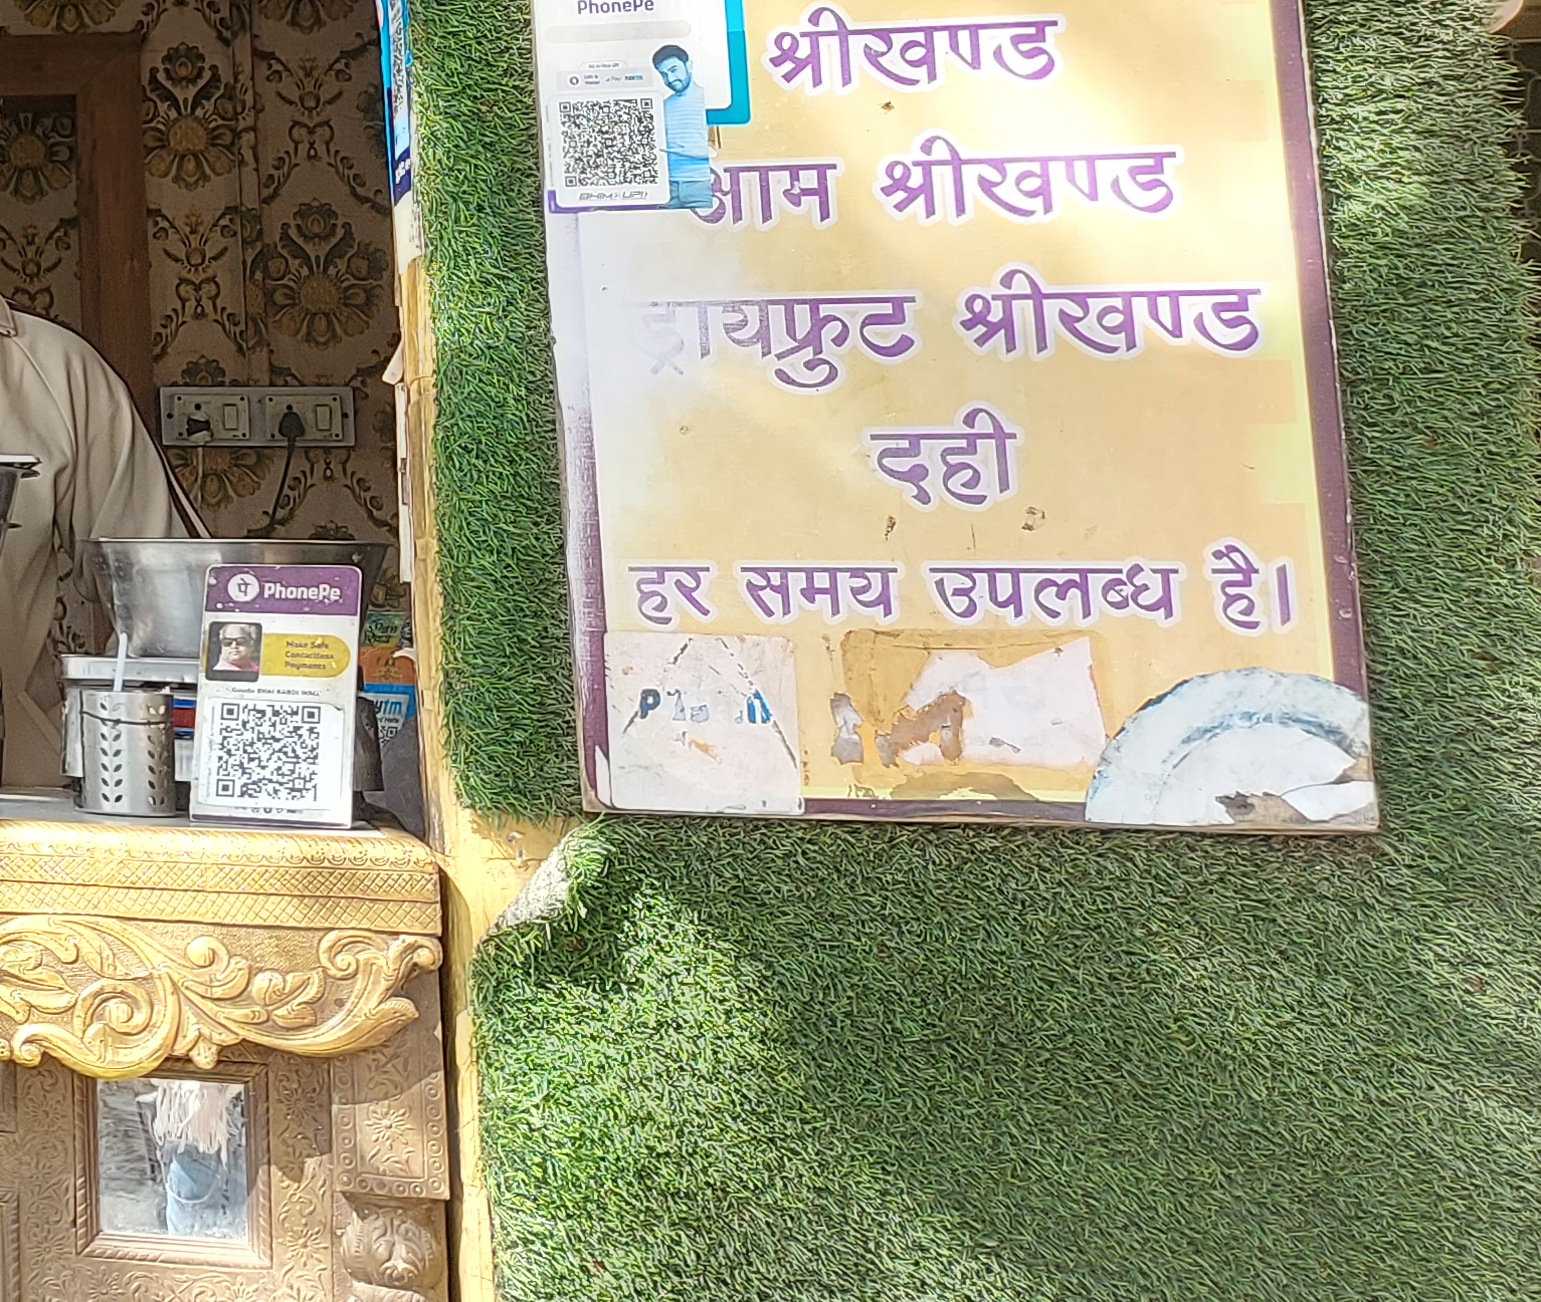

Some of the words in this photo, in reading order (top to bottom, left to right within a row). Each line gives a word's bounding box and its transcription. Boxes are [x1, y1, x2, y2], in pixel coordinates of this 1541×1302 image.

[769, 9, 1060, 88] श्रीखण्ड
[883, 135, 1176, 219] श्रीखण्ड
[959, 268, 1262, 354] श्रीखण्ड
[869, 408, 1018, 504] दही
[264, 582, 341, 601] PhonePe
[629, 566, 713, 624] हर
[740, 566, 898, 620] समय
[928, 564, 1179, 621] उपलब्ध
